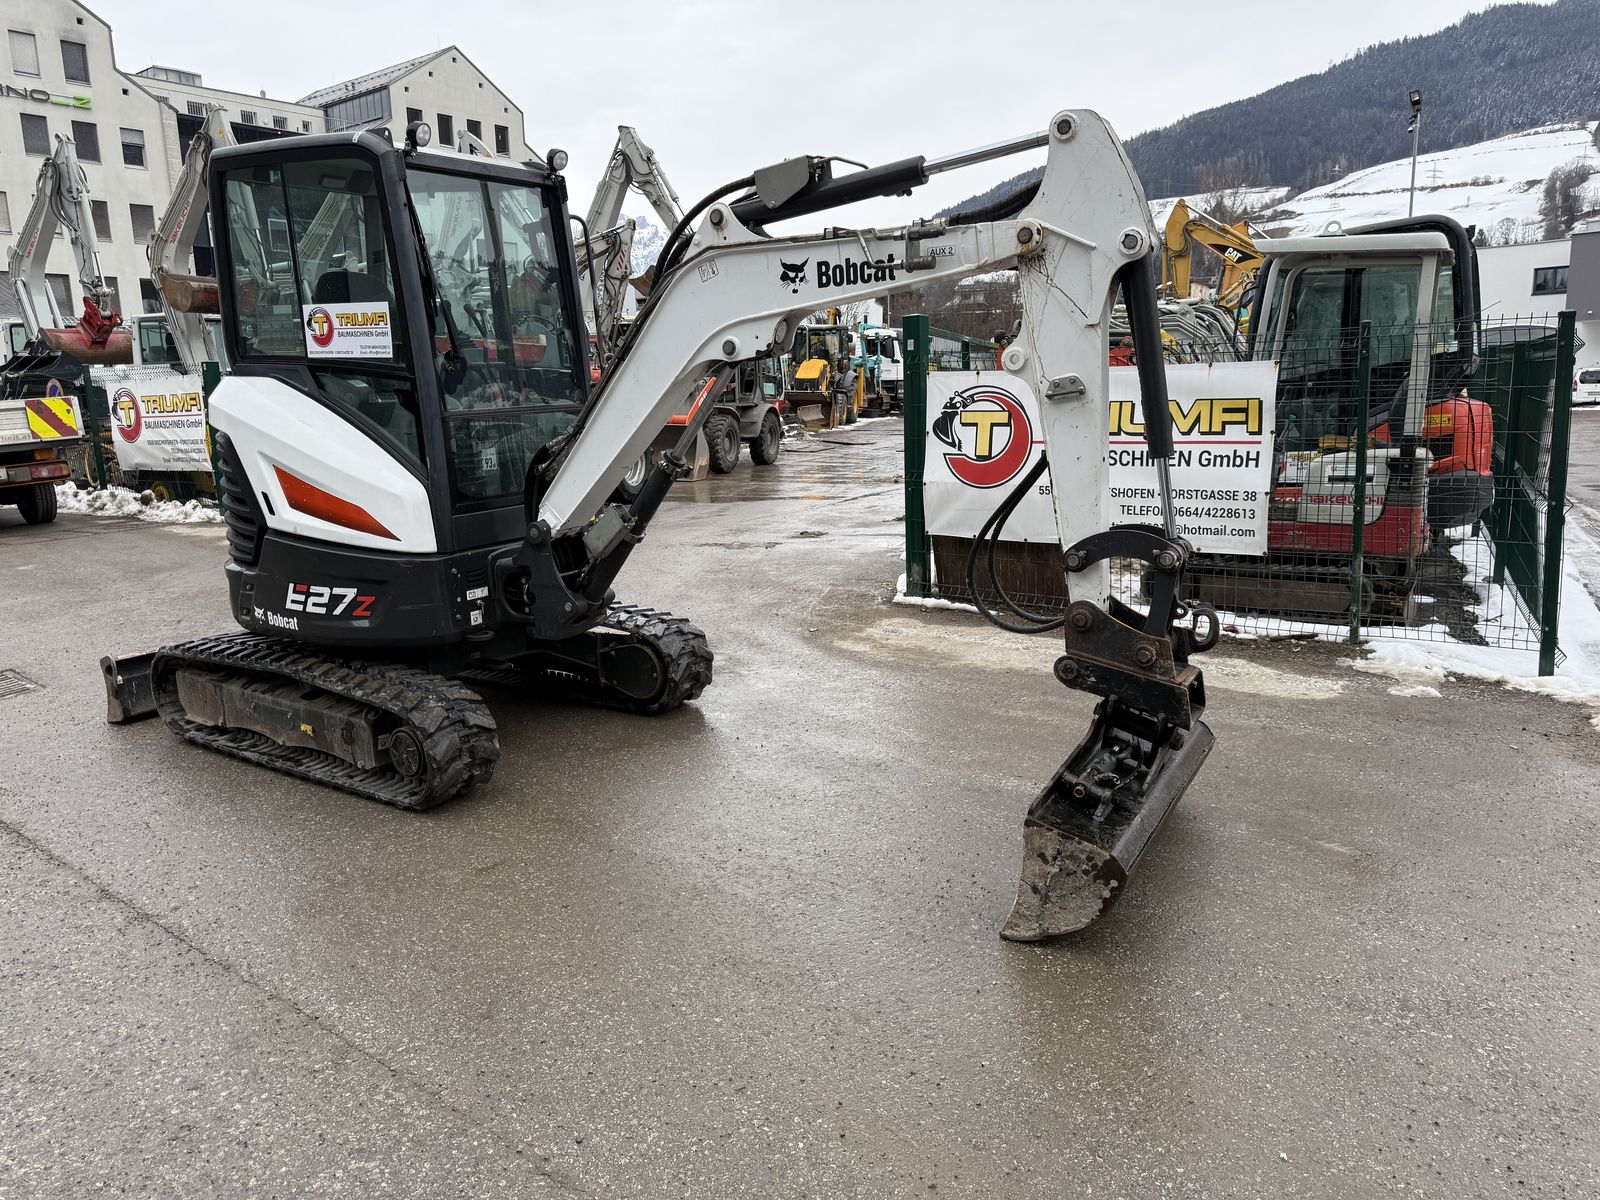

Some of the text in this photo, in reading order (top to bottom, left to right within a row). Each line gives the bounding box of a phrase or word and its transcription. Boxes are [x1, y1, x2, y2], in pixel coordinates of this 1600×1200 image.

[930, 246, 954, 256] AUX 2
[1225, 247, 1243, 262] CAT
[816, 253, 896, 289] Bobcat
[335, 312, 388, 327] TRIUMFI
[141, 392, 202, 414] TRIUMFI
[144, 419, 203, 430] BAUMASCHINEN GmbH
[1109, 398, 1263, 436] IUMFI
[1198, 449, 1260, 468] GmbH
[1171, 488, 1239, 501] ORSTGASSE
[1242, 490, 1257, 502] 38
[1120, 504, 1163, 516] TELEFO
[267, 611, 299, 631] Bobcat
